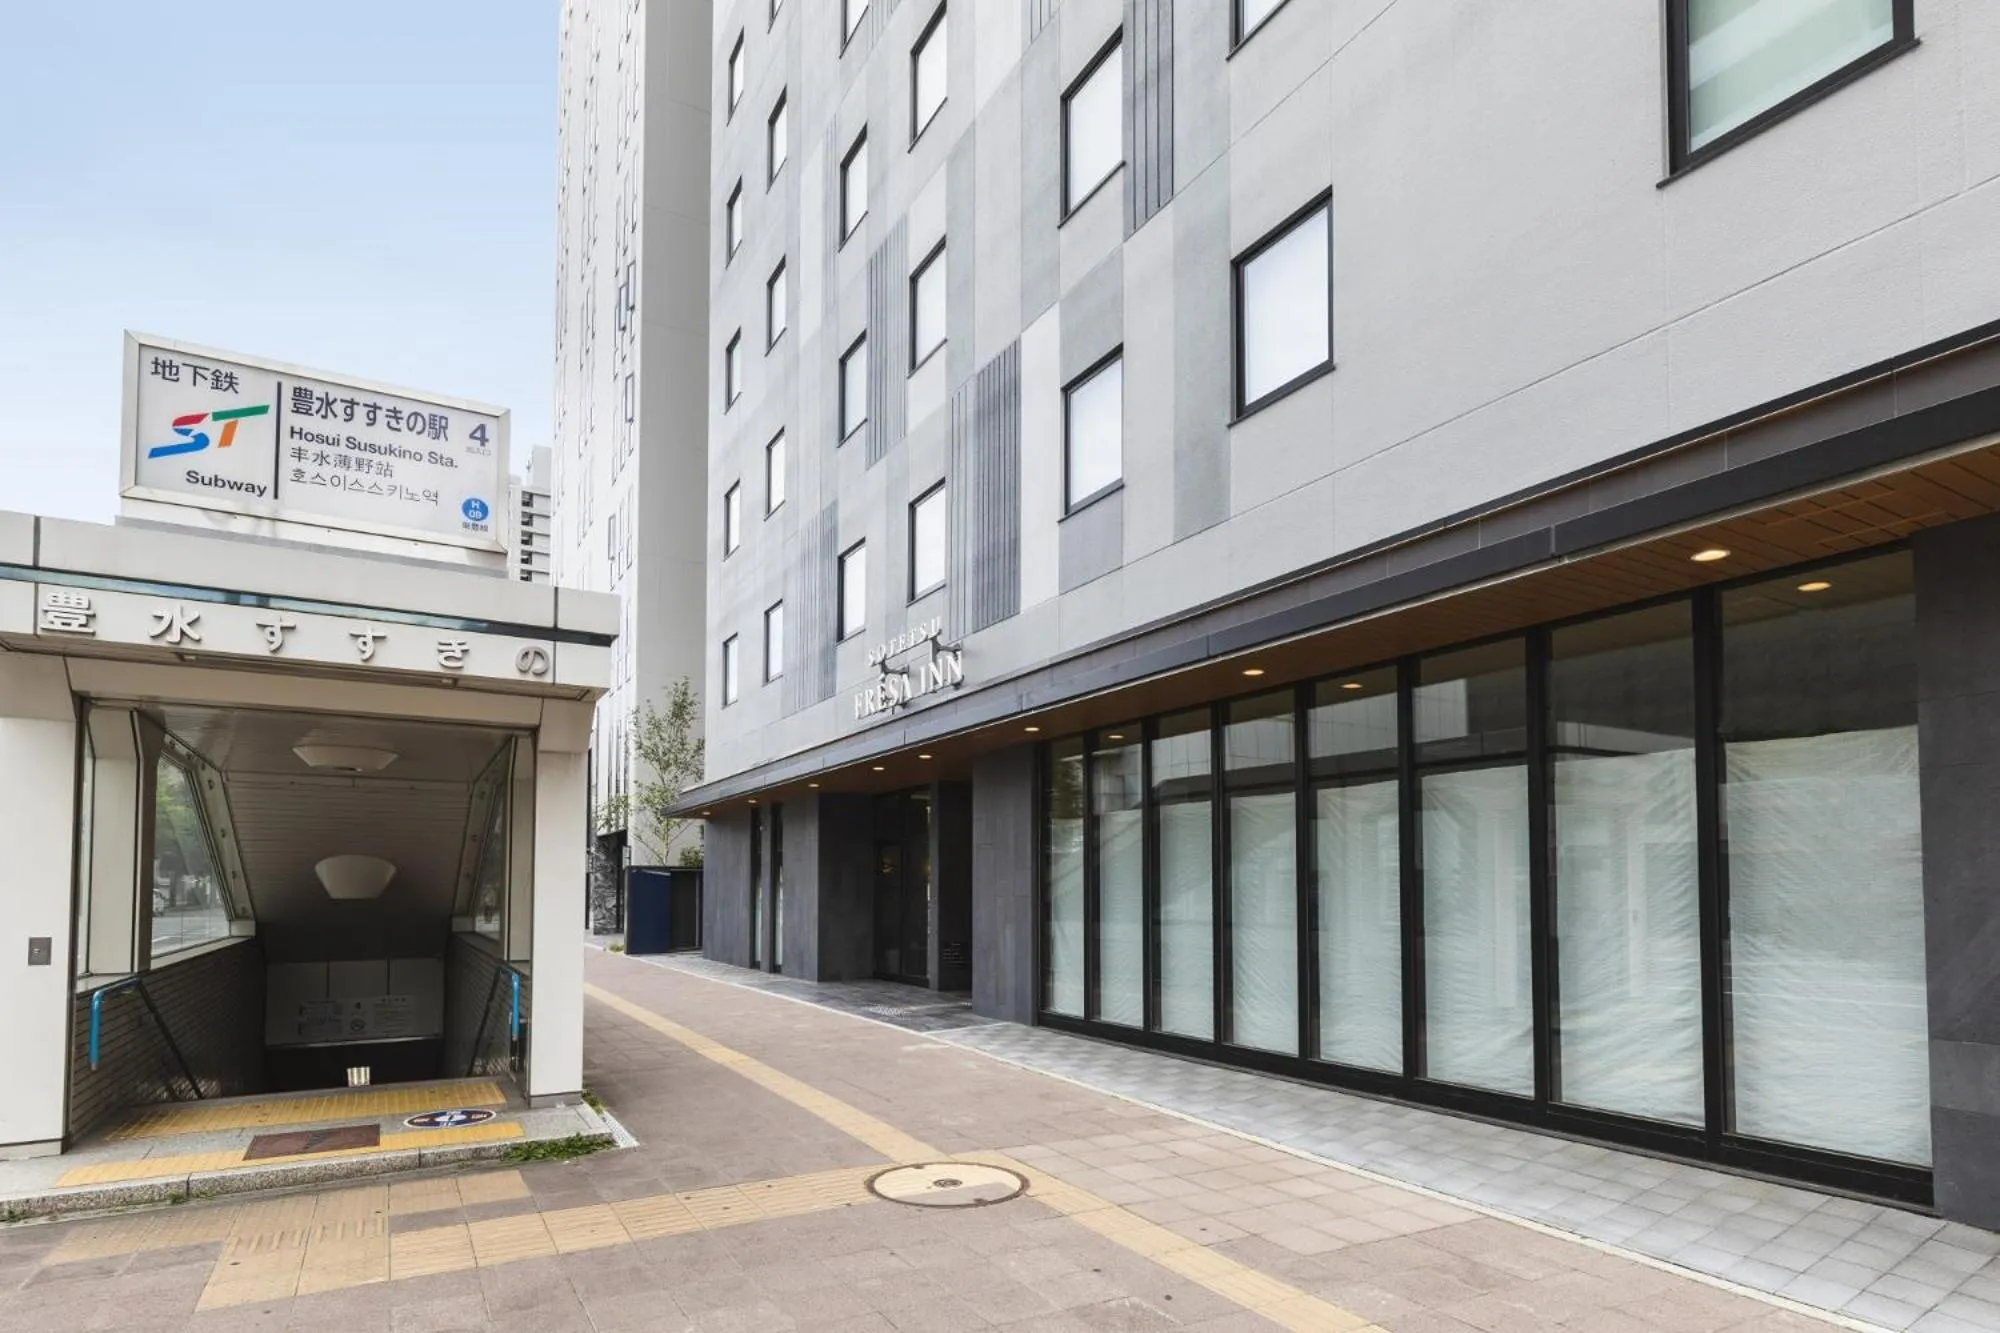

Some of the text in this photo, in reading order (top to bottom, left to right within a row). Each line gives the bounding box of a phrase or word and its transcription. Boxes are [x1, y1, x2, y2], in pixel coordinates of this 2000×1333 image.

[150, 356, 240, 394] 地下鉄
[290, 386, 449, 442] 豊水すすきの駅
[290, 425, 341, 448] Hosui
[345, 437, 424, 463] Susukino
[427, 450, 459, 469] Sta.
[468, 423, 490, 447] 4
[290, 446, 394, 479] 丰水薄野站
[185, 469, 268, 498] Subway
[290, 467, 439, 506] 호스이스스키노역
[40, 592, 551, 676] 豊水すすきの
[919, 650, 963, 695] INN
